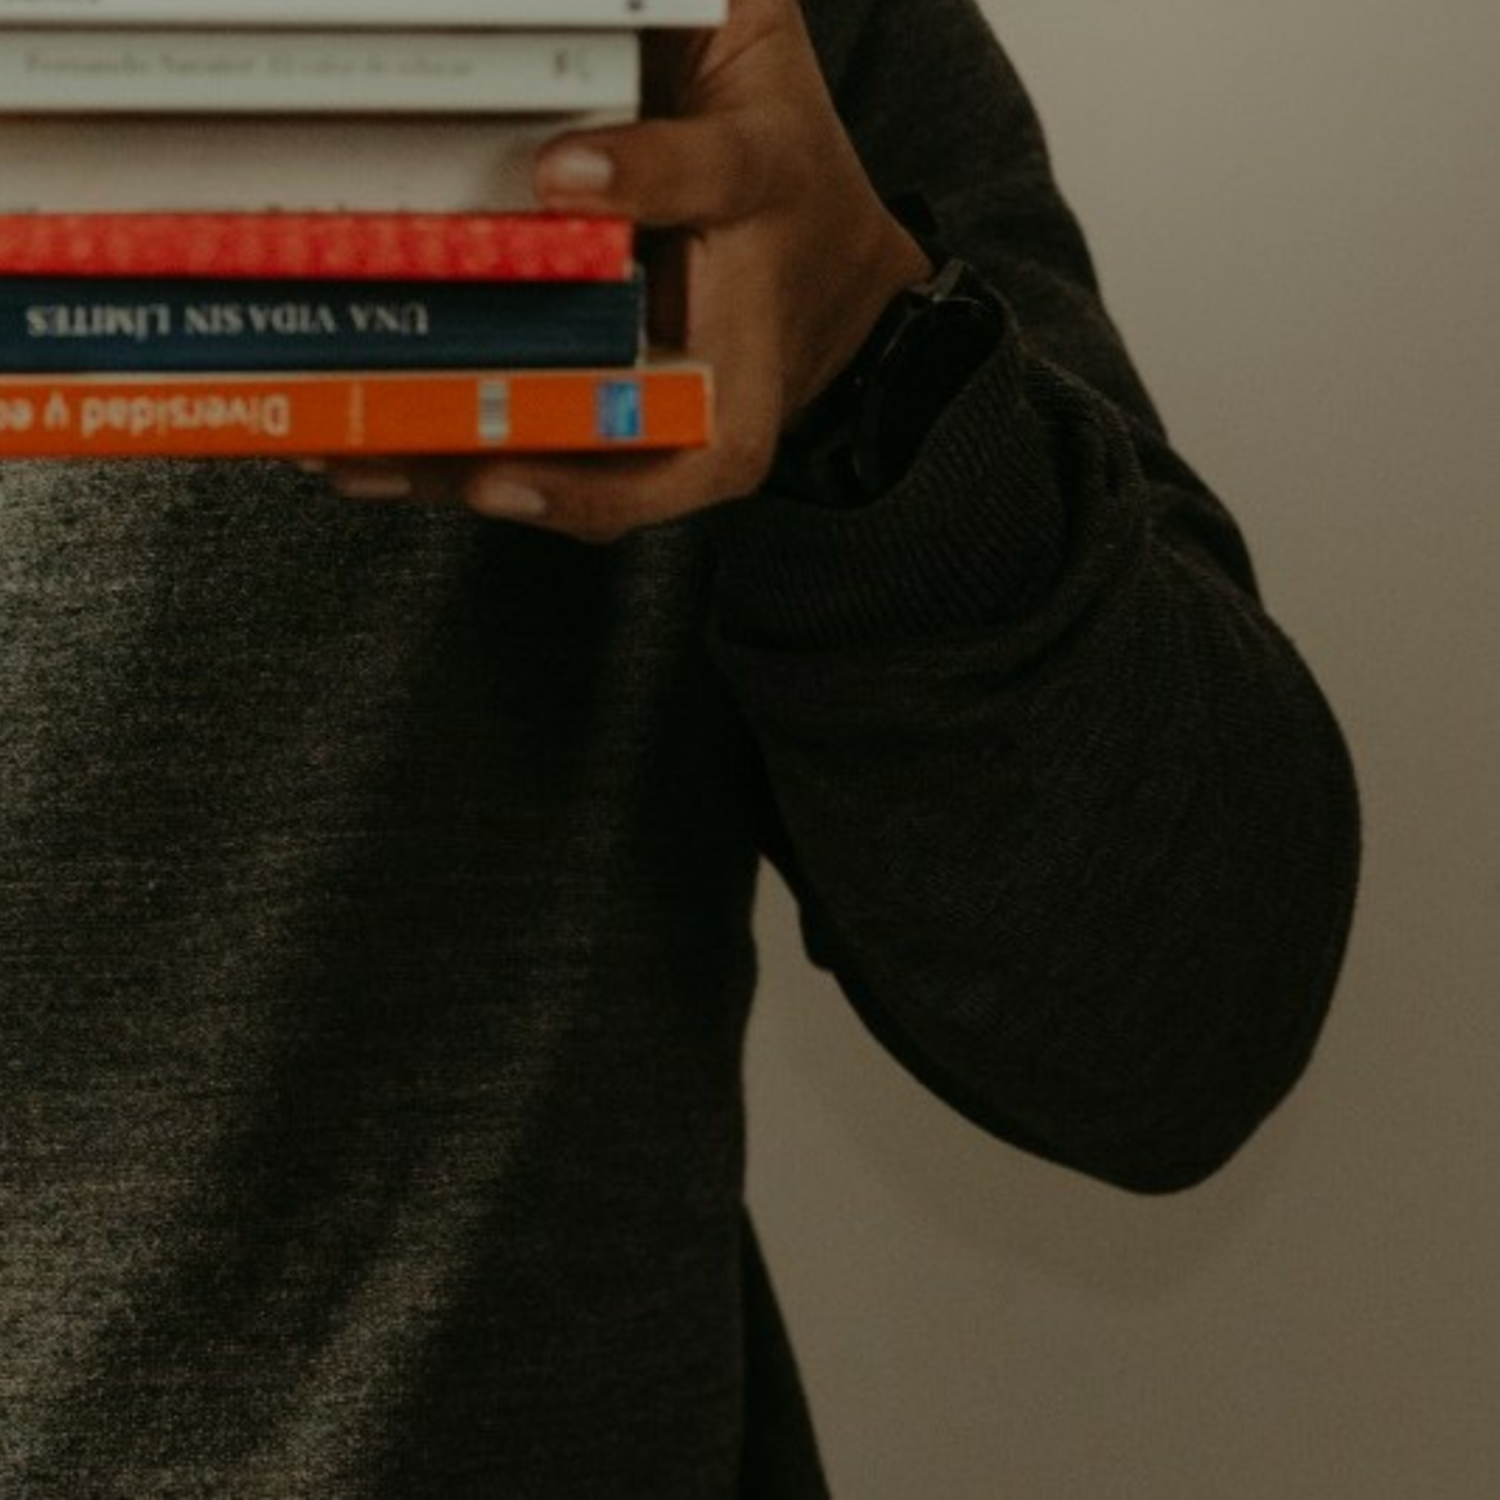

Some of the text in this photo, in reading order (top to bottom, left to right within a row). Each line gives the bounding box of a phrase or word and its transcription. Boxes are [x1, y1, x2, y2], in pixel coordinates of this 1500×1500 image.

[25, 302, 430, 341] UNA VIDA SIN LÍMITES
[44, 395, 71, 428] y
[79, 395, 291, 437] Diversidad
